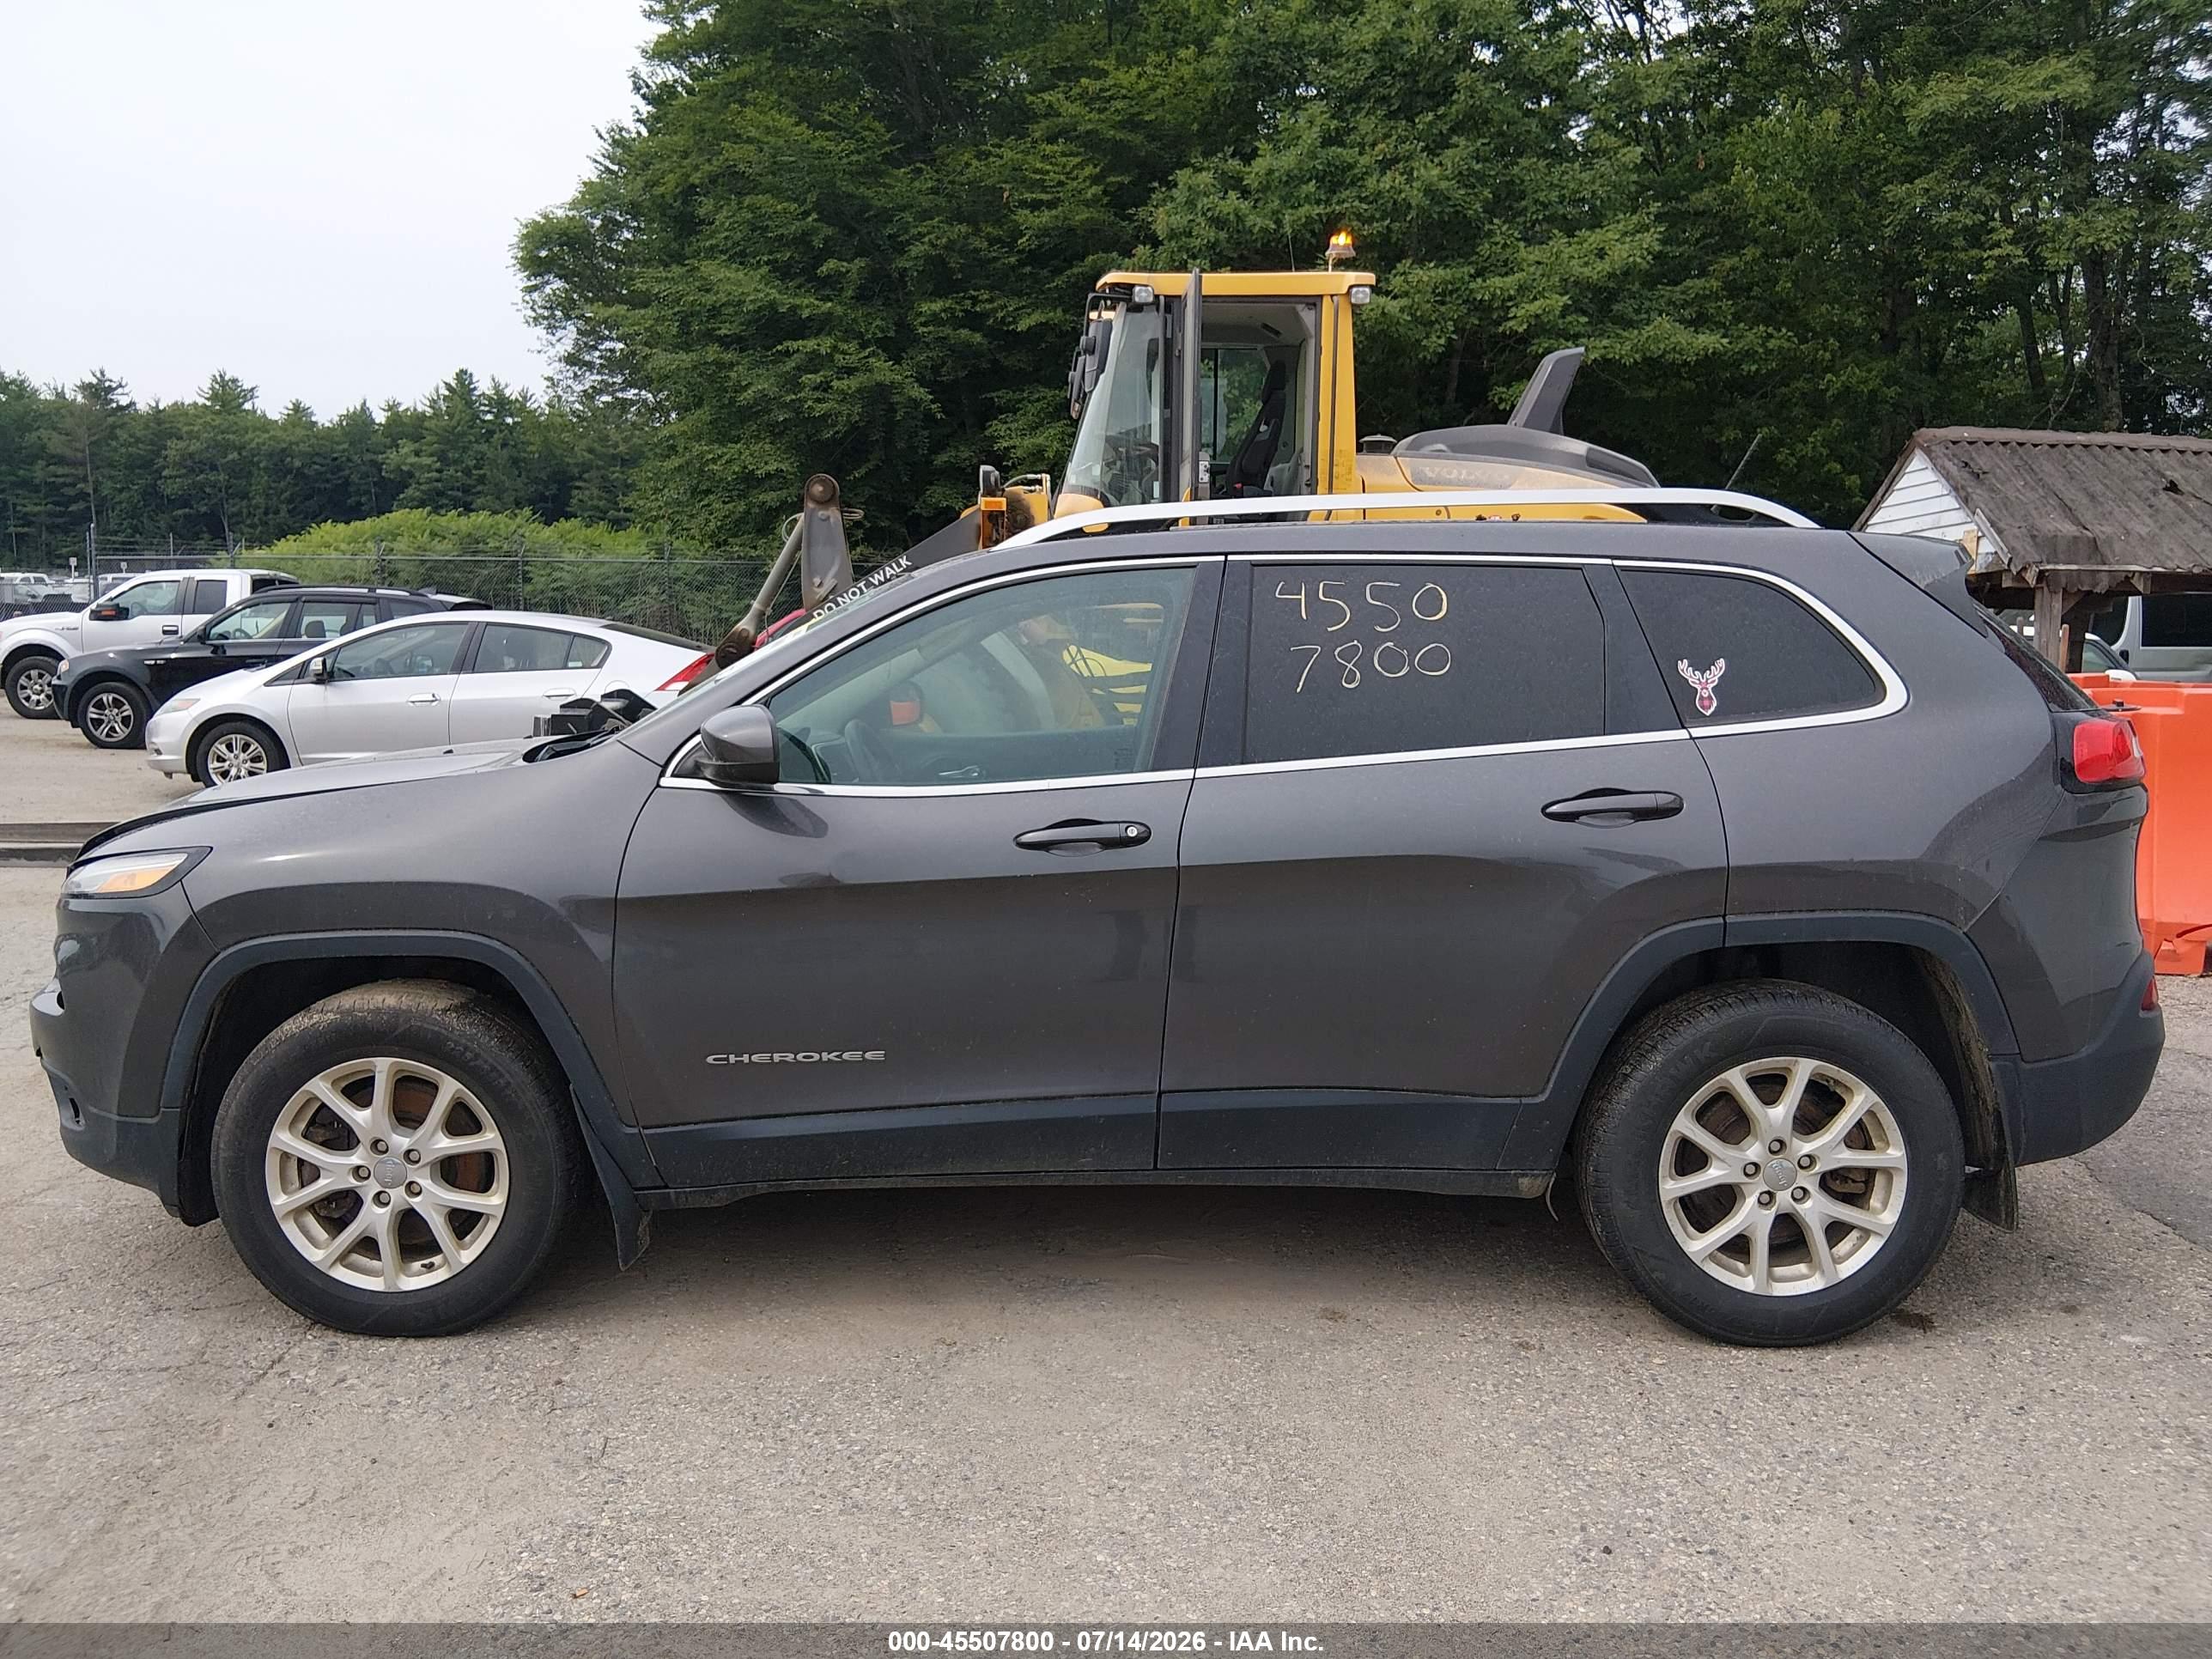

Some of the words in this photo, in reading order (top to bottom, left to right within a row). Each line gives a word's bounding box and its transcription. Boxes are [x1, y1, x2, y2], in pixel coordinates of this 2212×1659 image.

[812, 602, 837, 619] DO
[836, 580, 869, 606] NOT
[868, 555, 913, 586] WALK
[1275, 580, 1448, 631] 4550
[1289, 640, 1451, 693] 7800
[705, 1050, 886, 1065] CHEROKEE
